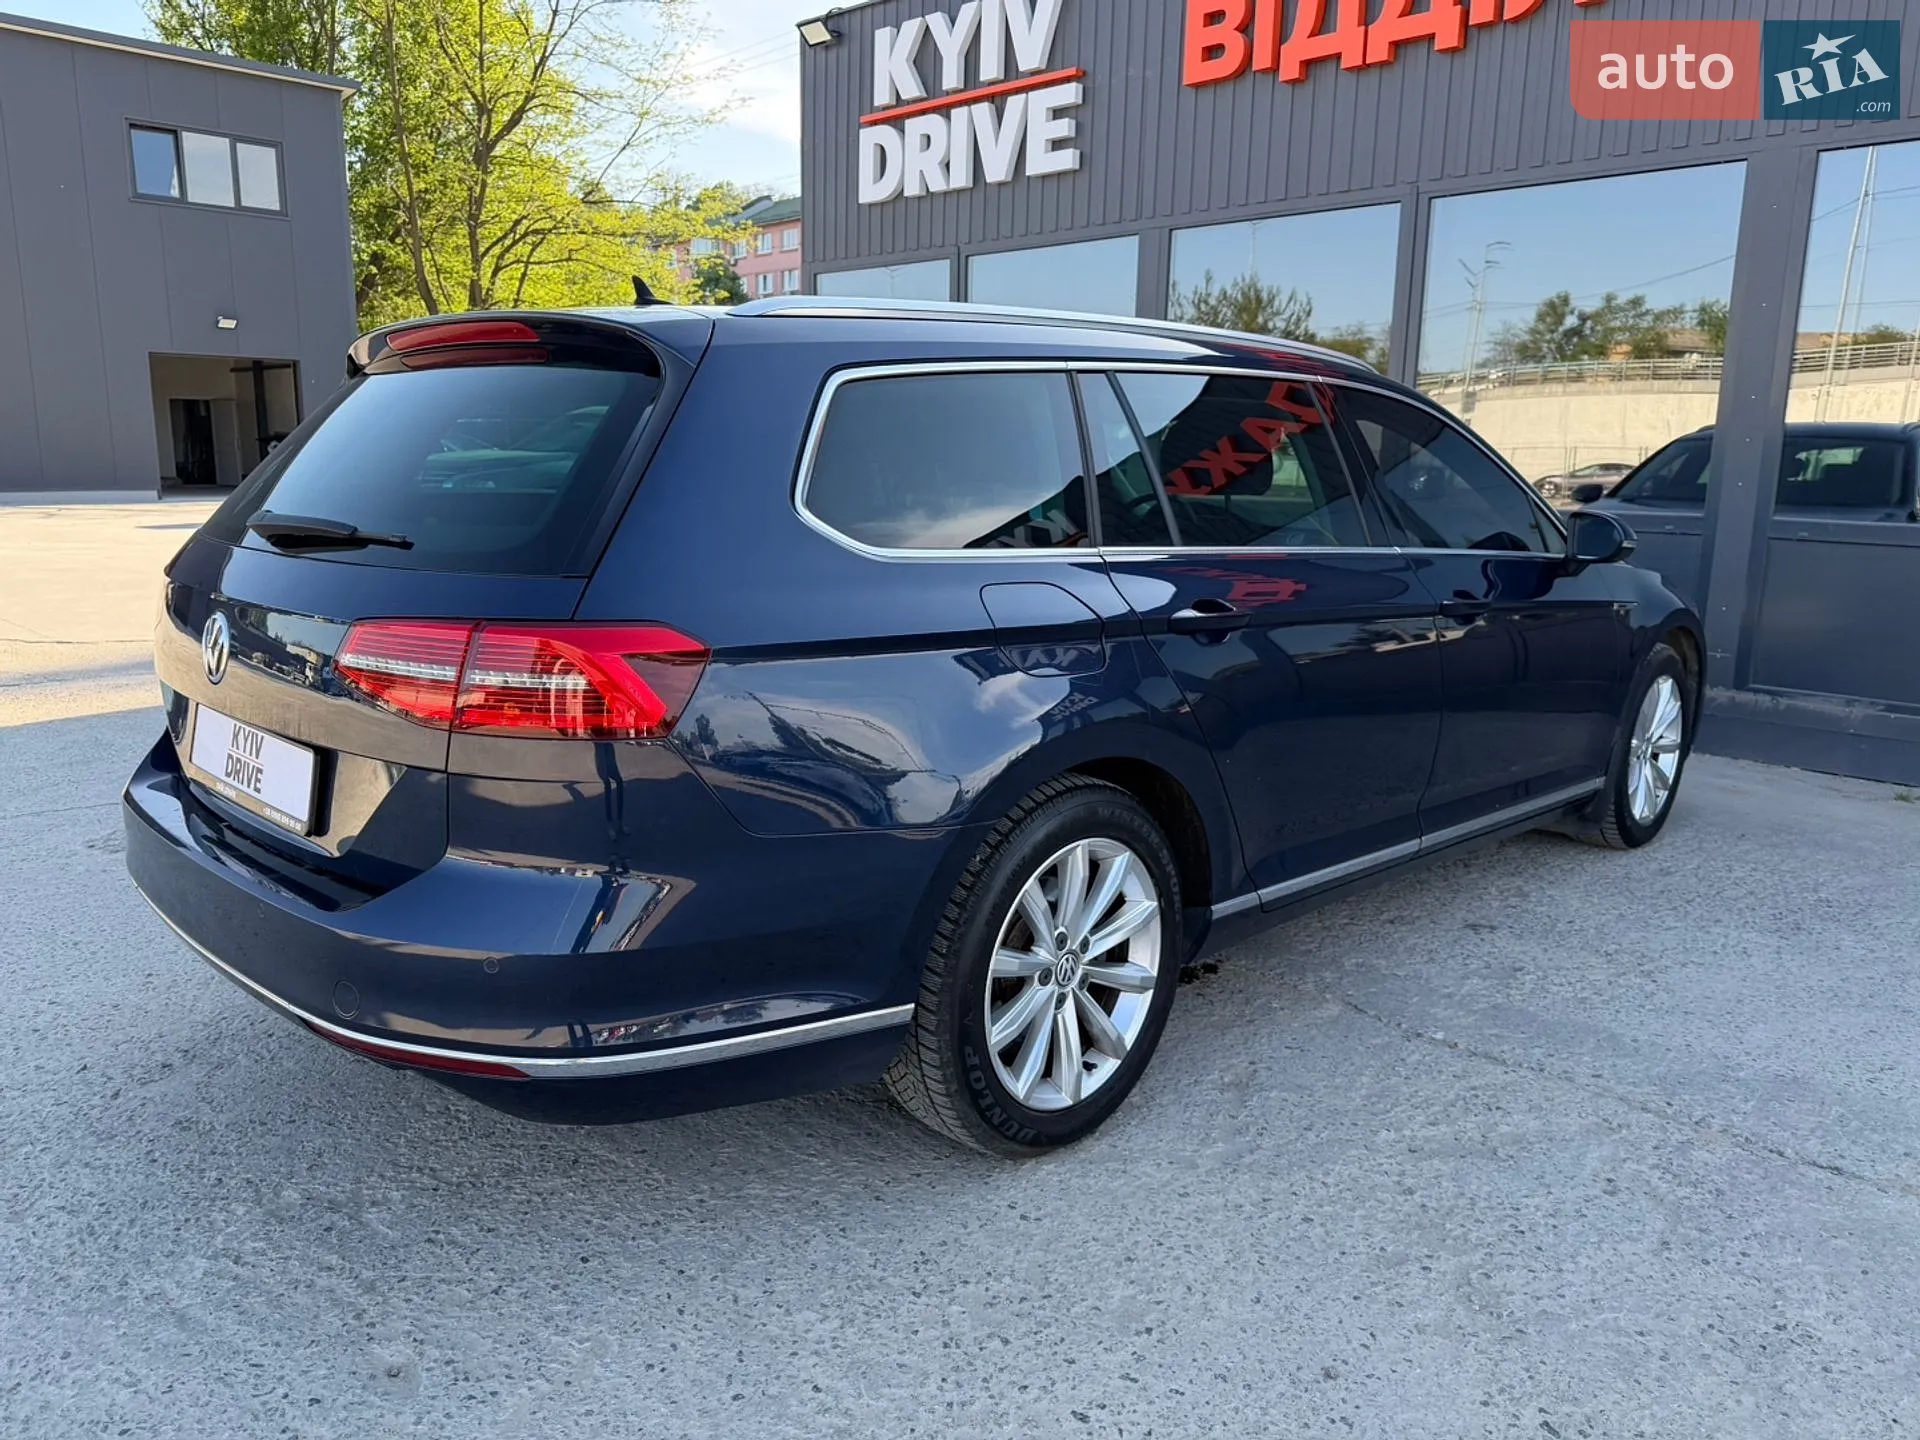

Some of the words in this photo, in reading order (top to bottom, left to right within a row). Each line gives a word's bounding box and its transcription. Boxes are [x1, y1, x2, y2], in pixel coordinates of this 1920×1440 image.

[874, 0, 1062, 108] KYIV
[859, 82, 1083, 204] DRIVE
[224, 755, 264, 795] DRIVE
[231, 722, 265, 760] KYIV
[964, 1046, 1039, 1142] DUNLOP
